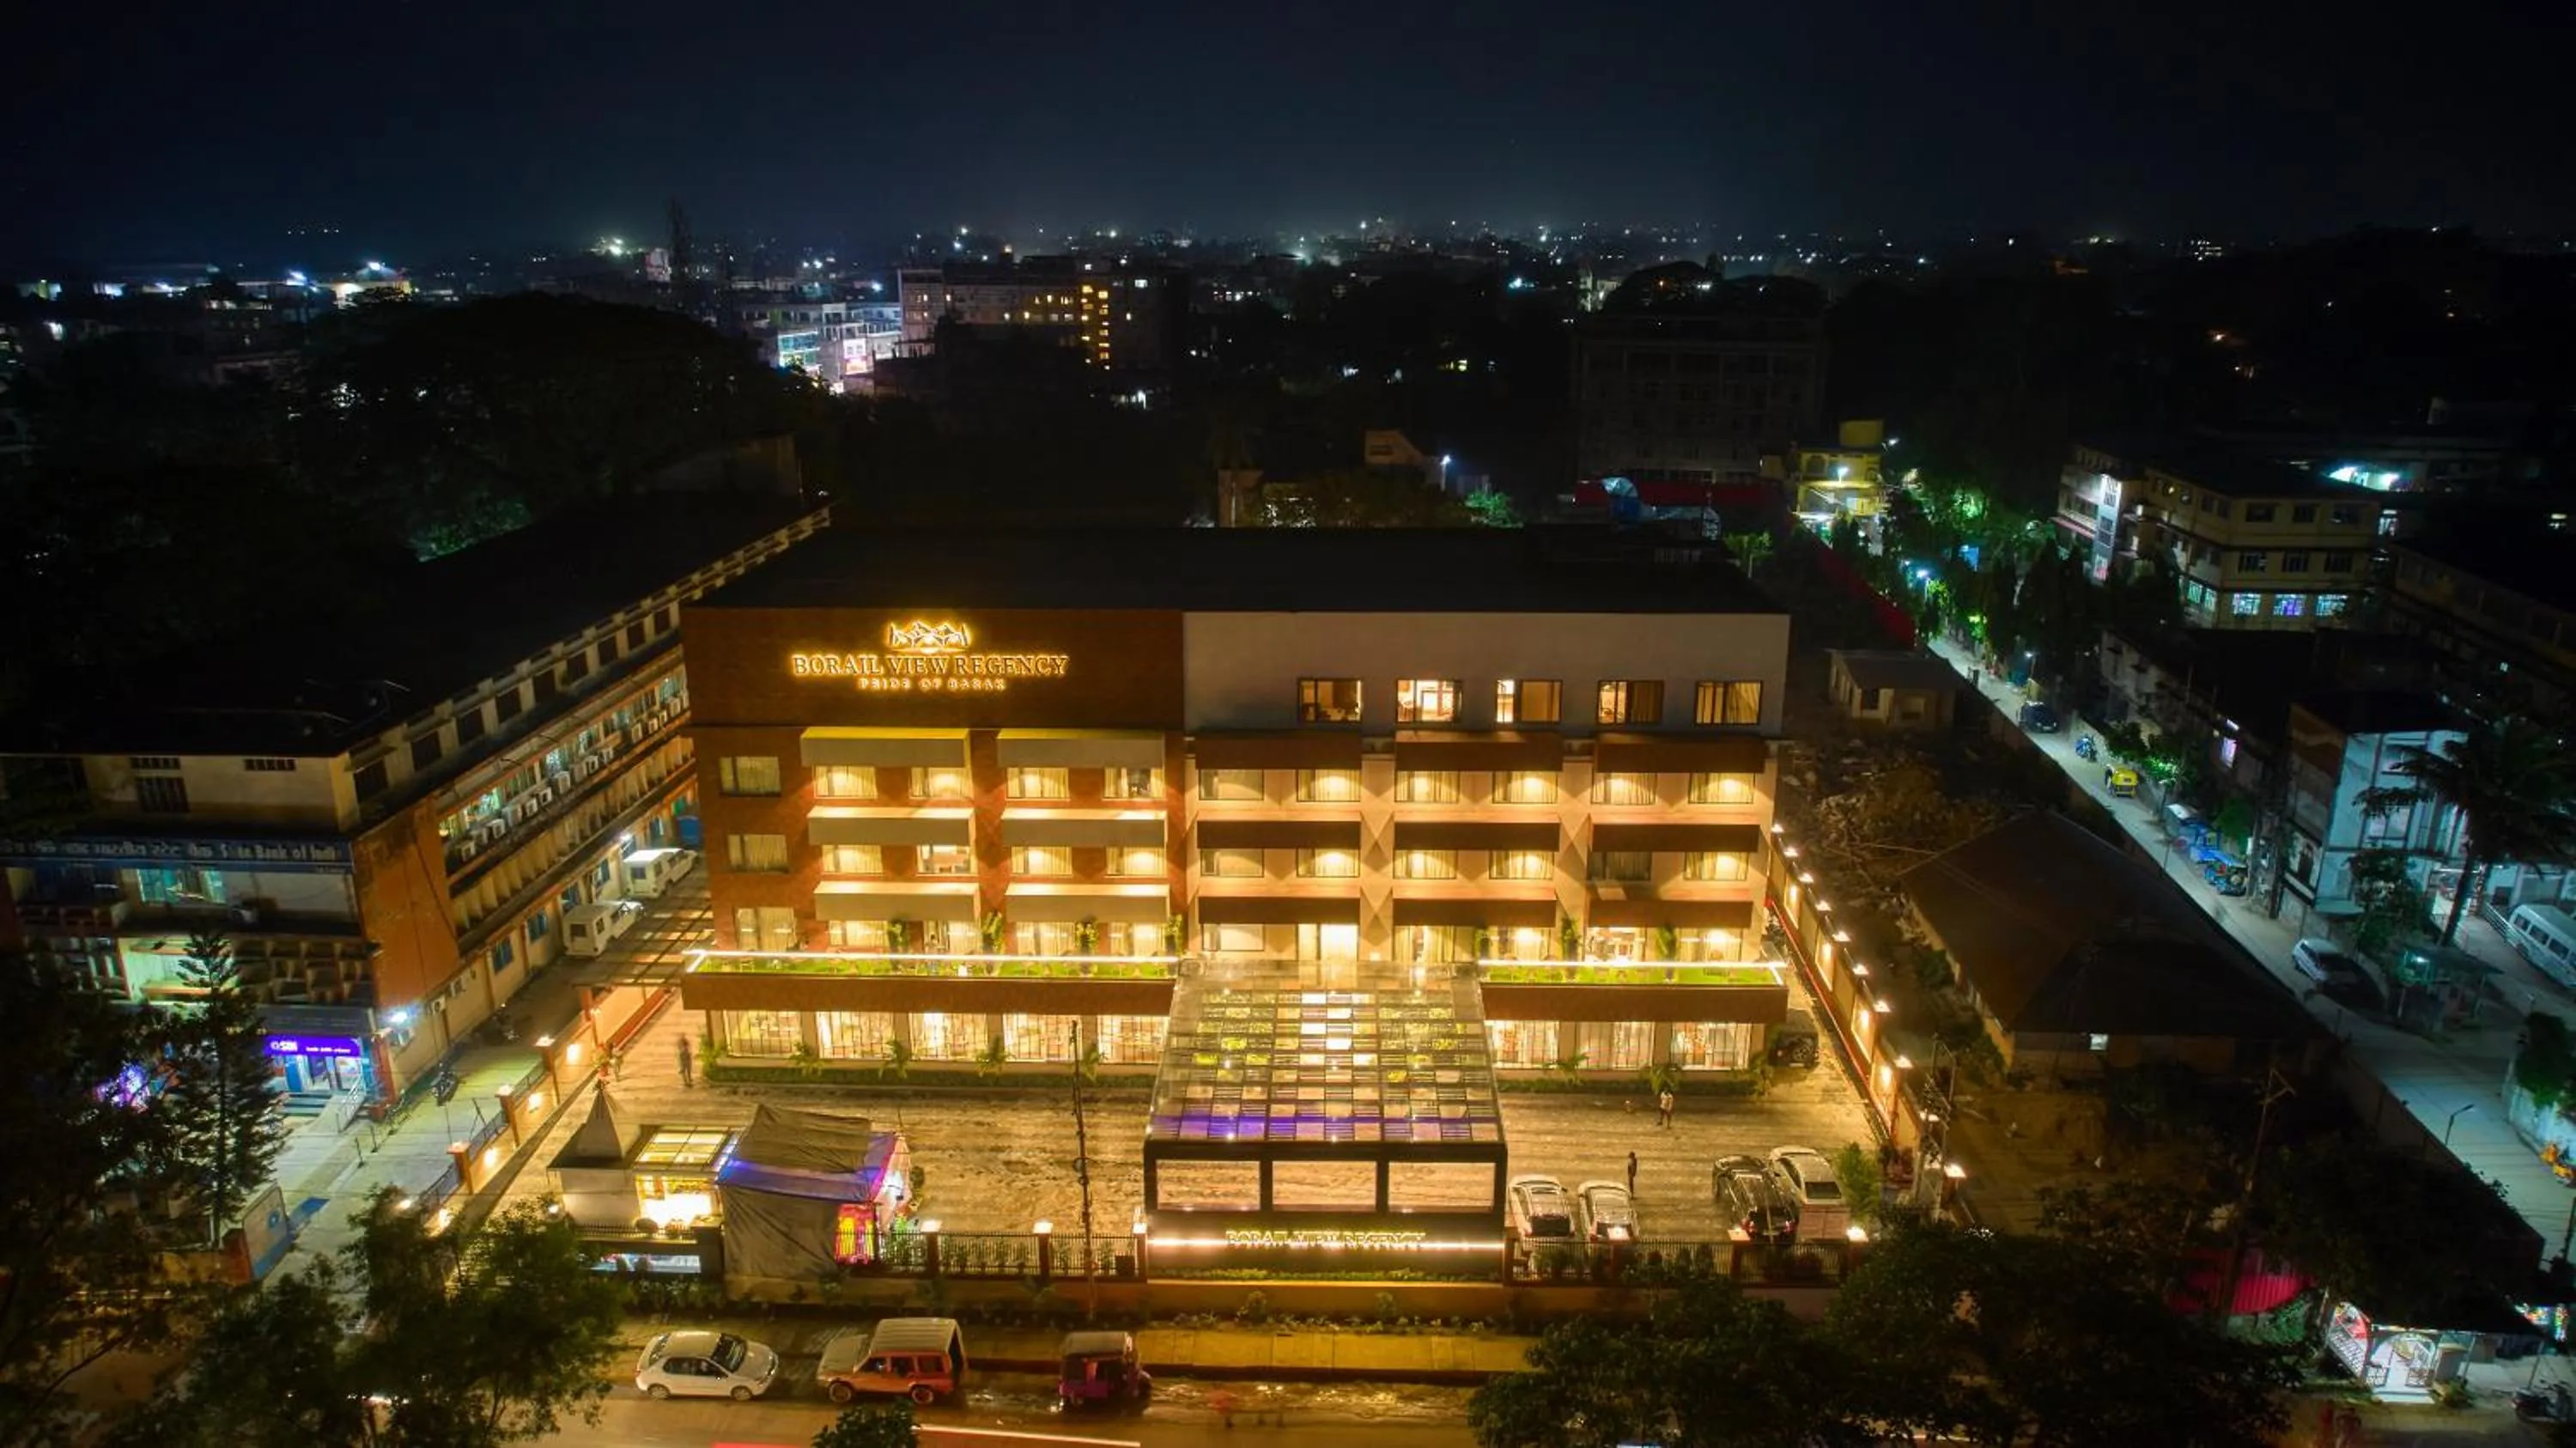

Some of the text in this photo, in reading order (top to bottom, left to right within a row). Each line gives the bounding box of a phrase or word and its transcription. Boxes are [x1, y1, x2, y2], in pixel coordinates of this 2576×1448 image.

[793, 654, 1069, 676] BORAIL VIEW REGENCY
[859, 677, 1005, 691] PRIDE OF BARAK
[254, 844, 288, 858] Bank
[291, 843, 307, 859] of
